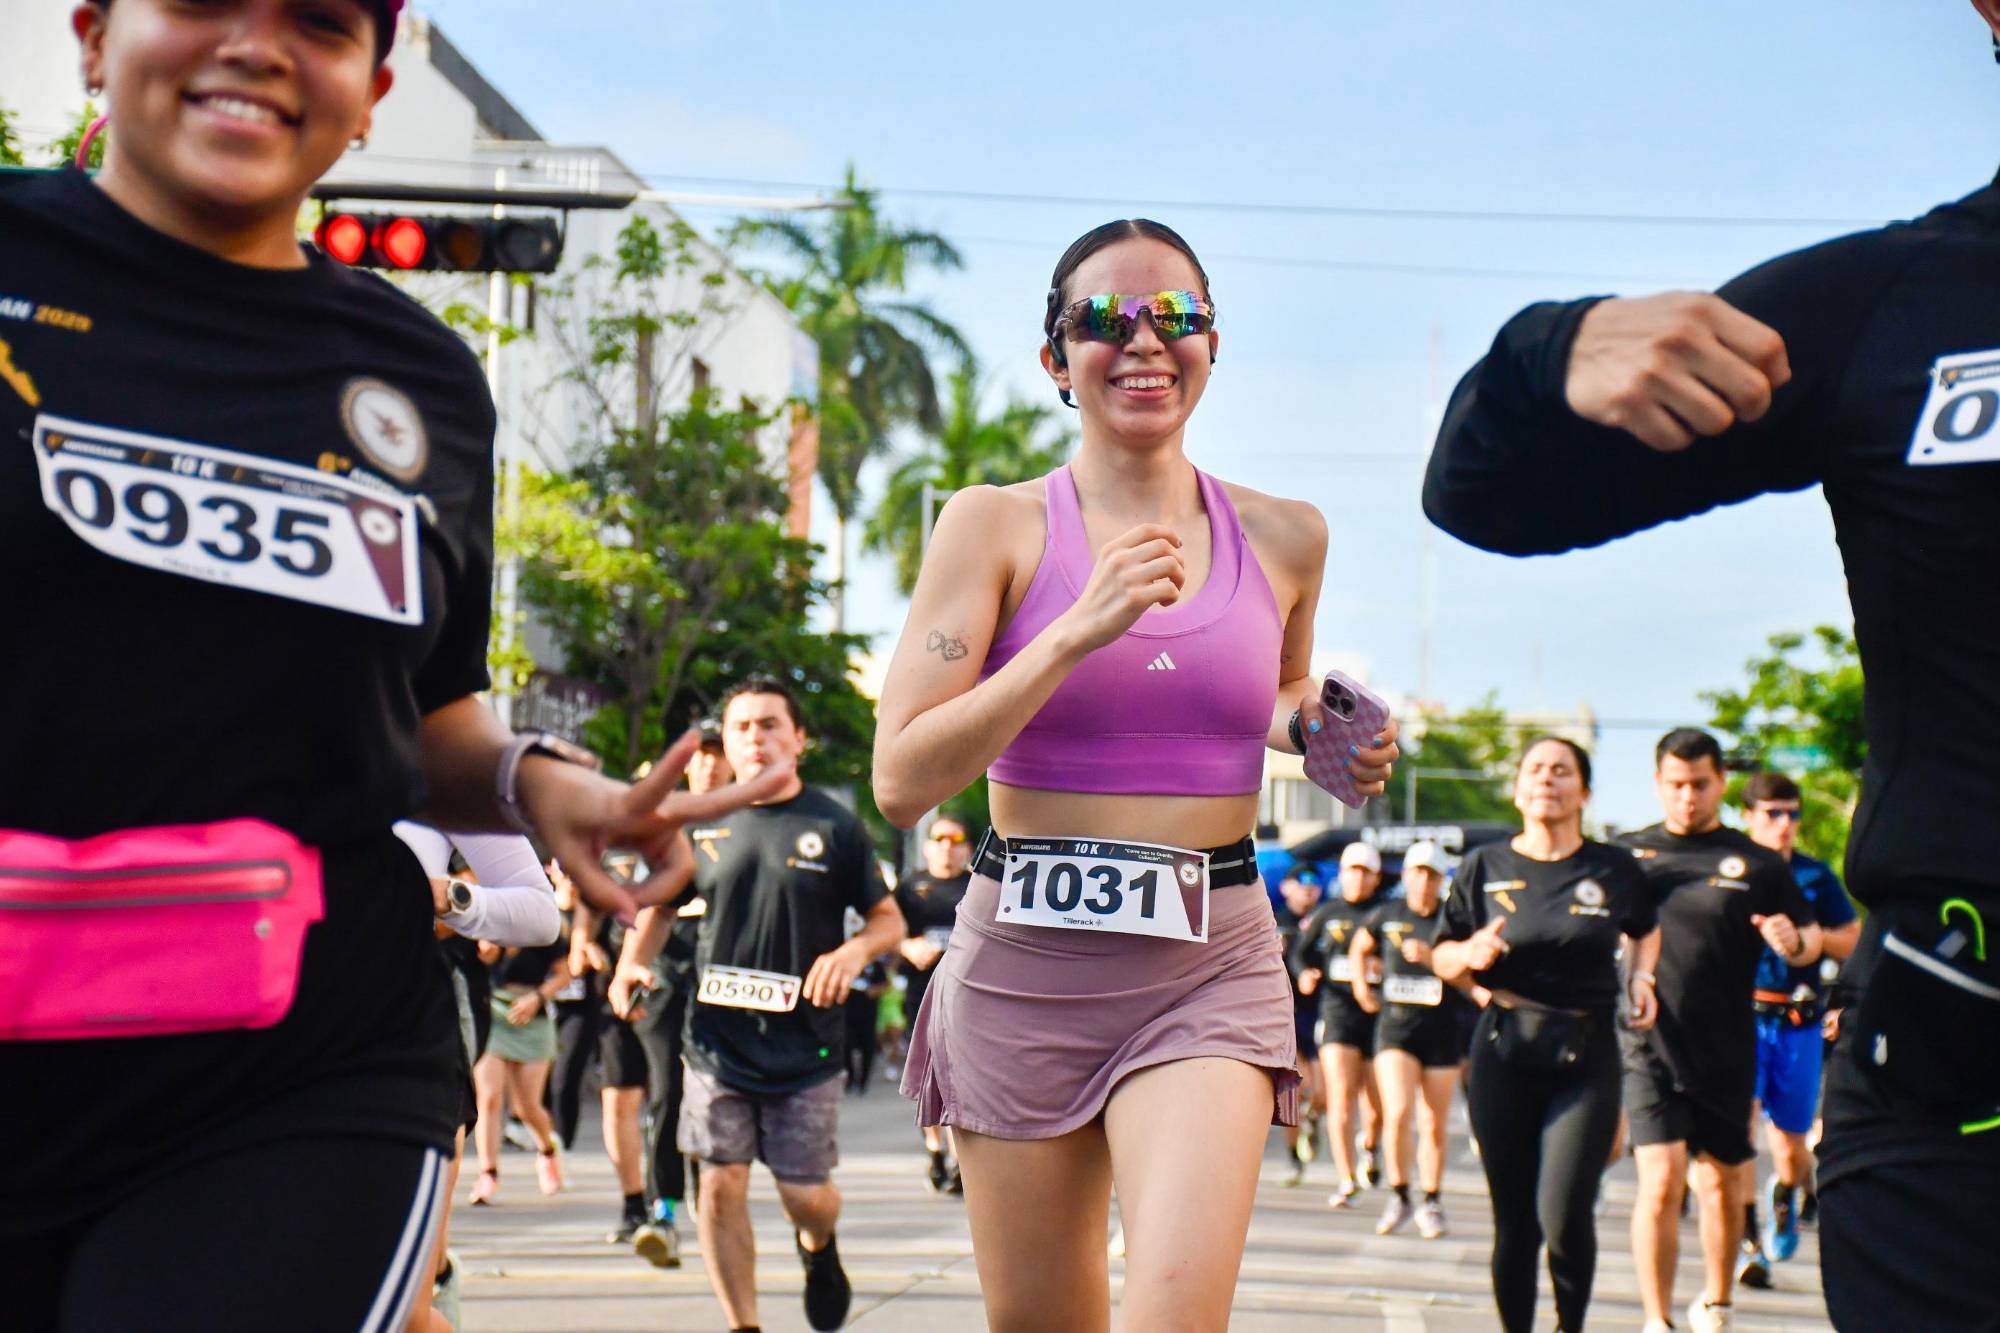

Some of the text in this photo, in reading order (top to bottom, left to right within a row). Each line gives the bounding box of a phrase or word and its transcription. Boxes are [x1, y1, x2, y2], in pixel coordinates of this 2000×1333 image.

[54, 468, 332, 578] 0935
[1074, 842, 1100, 855] 10 K
[1011, 860, 1158, 919] 1031
[706, 979, 773, 1002] 0590
